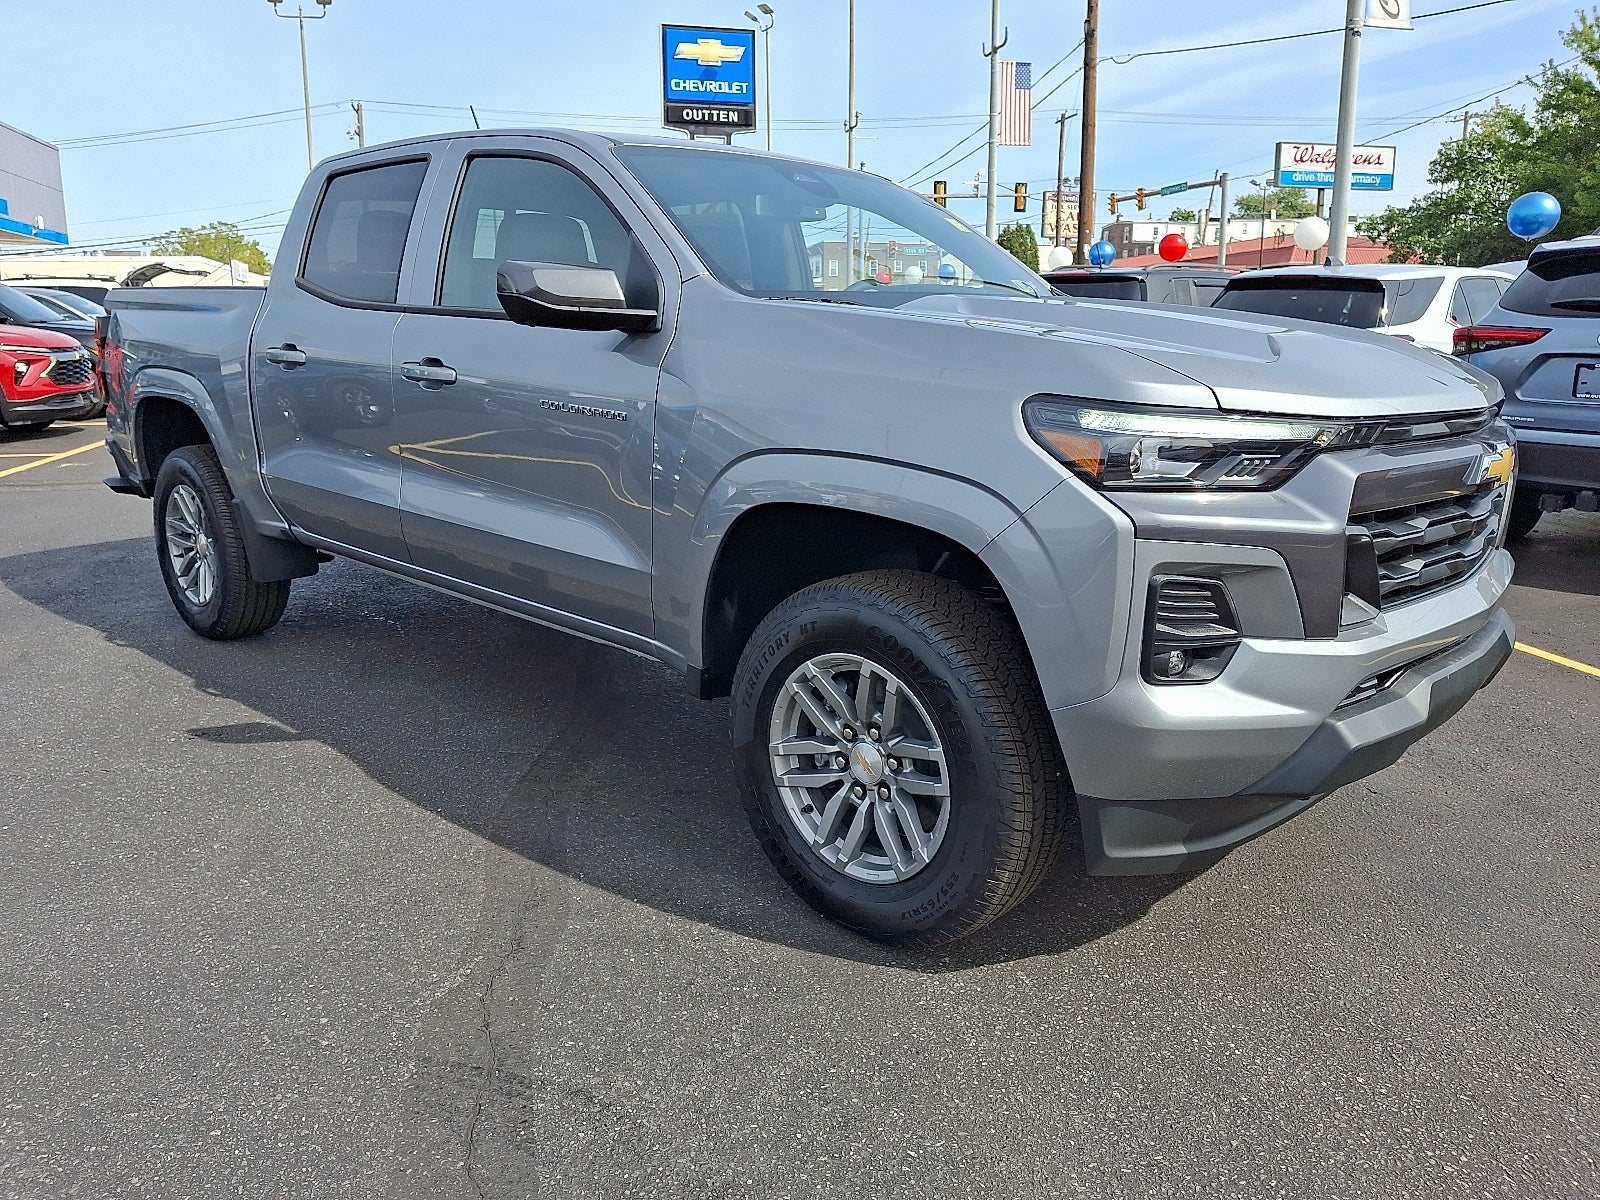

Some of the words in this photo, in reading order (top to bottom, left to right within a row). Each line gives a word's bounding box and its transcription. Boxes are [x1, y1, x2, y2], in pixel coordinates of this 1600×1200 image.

[670, 78, 748, 94] CHEVROLET
[682, 108, 738, 122] OUTTEN
[1292, 144, 1384, 170] Walgens
[1292, 172, 1315, 182] drive
[1317, 172, 1334, 183] thru
[539, 399, 628, 421] COLORADO
[742, 631, 790, 708] TERRITORY
[799, 620, 818, 636] HT
